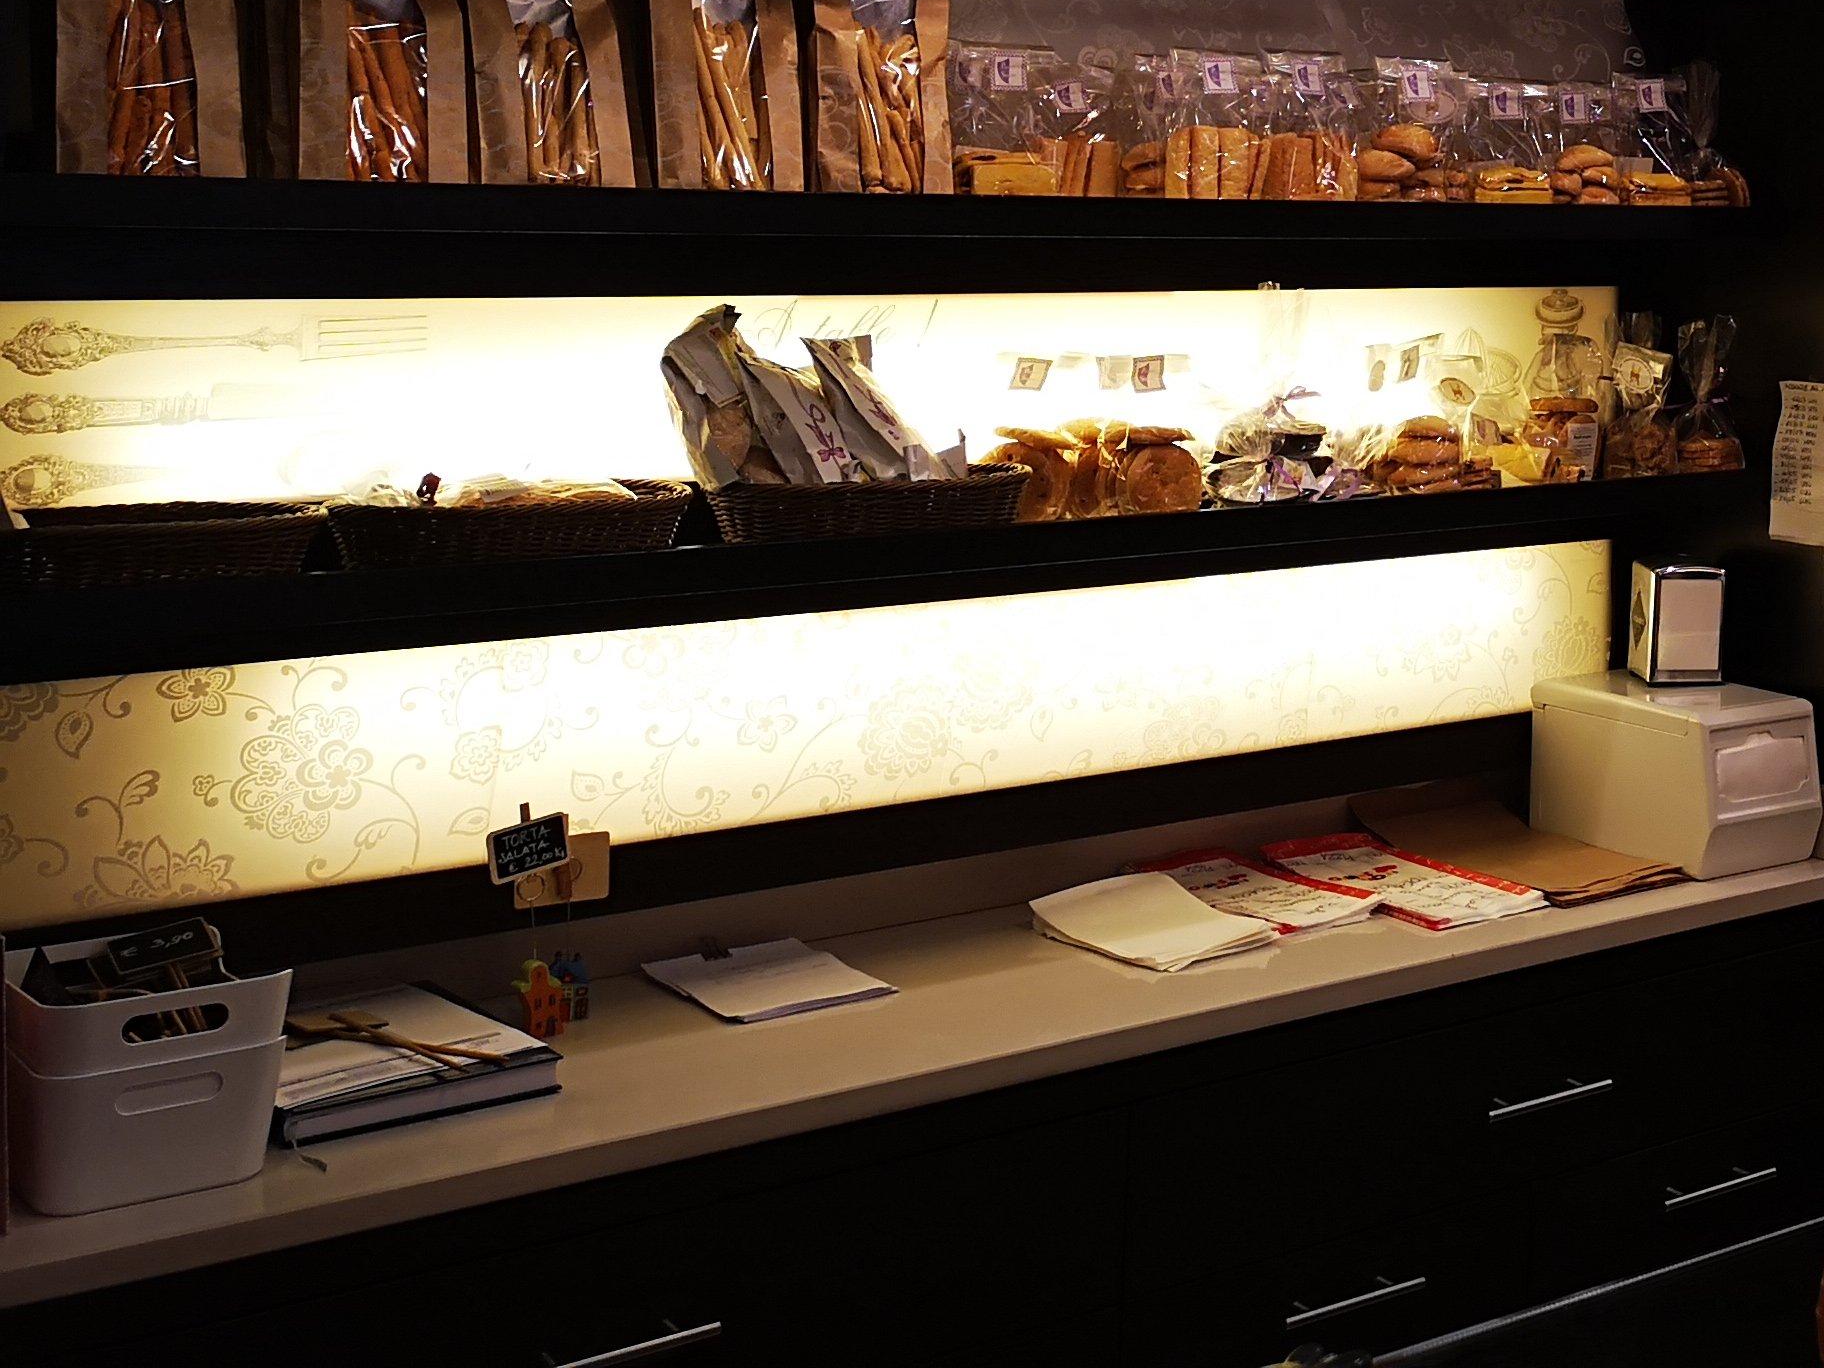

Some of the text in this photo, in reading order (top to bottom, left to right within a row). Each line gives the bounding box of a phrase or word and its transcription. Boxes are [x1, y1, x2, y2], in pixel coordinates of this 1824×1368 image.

[501, 824, 552, 850] TORTA
[497, 839, 550, 864] SALATA
[149, 930, 194, 950] 3,90
